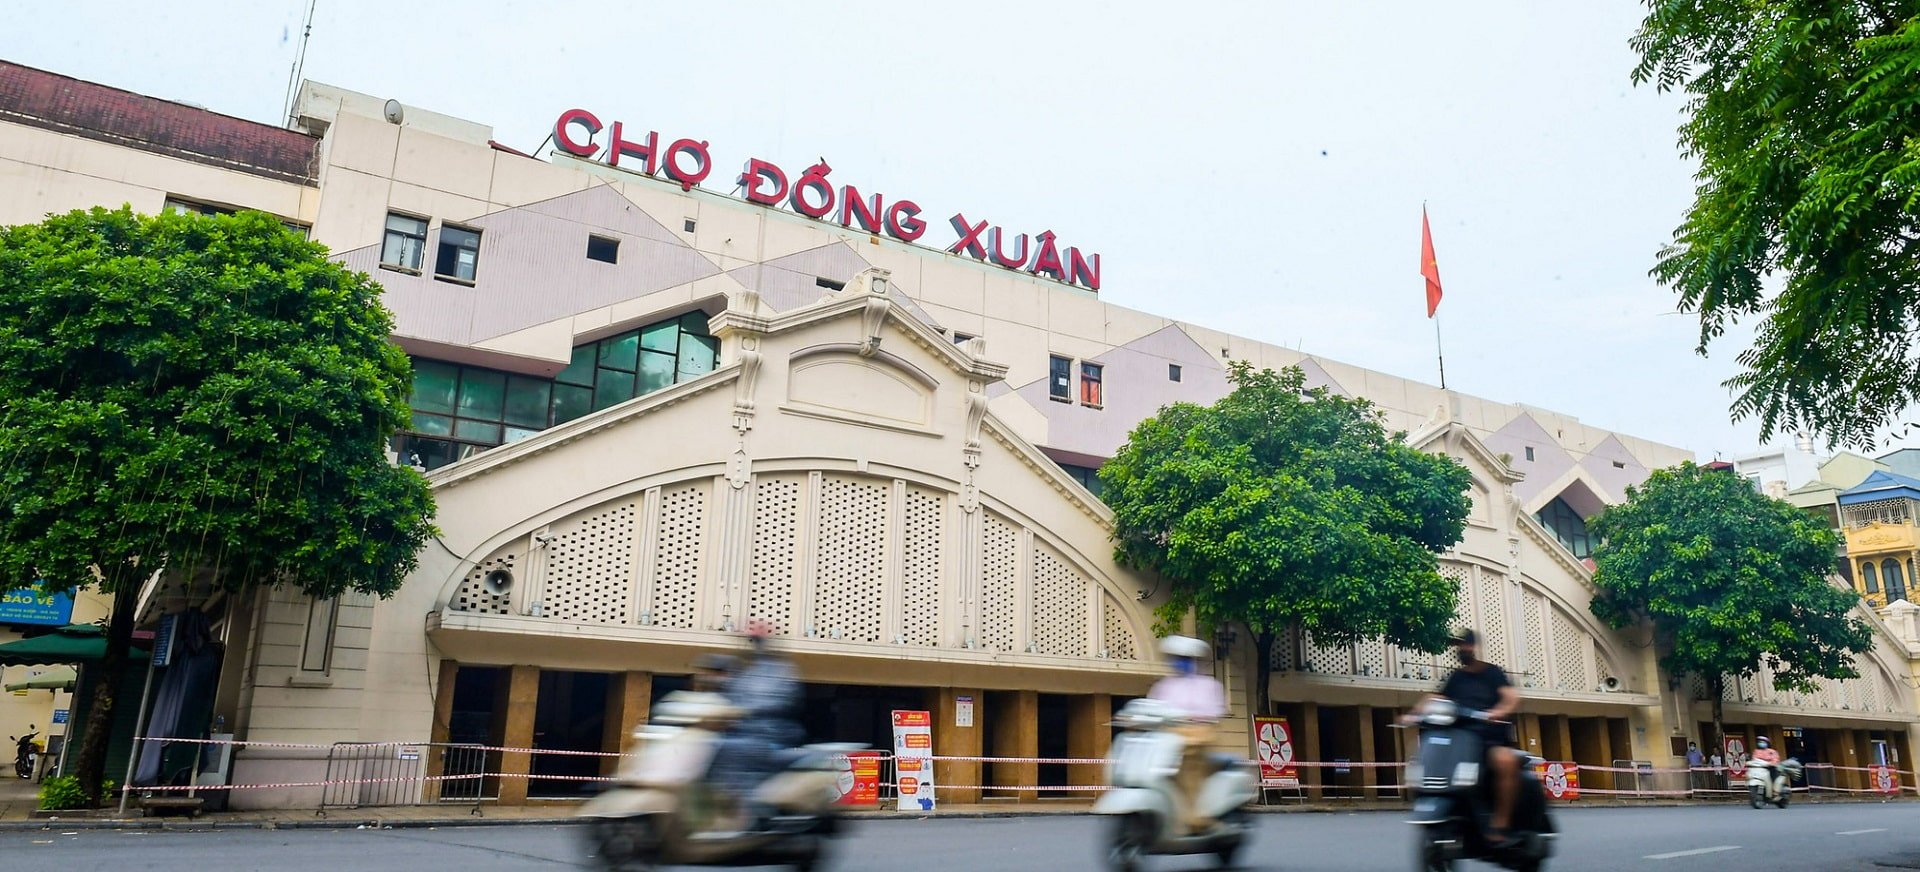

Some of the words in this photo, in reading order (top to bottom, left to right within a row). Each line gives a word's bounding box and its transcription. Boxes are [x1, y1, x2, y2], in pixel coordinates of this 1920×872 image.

[552, 108, 712, 192] CHỢ
[736, 157, 927, 242] ĐỒNG
[949, 212, 1100, 290] XUÂN
